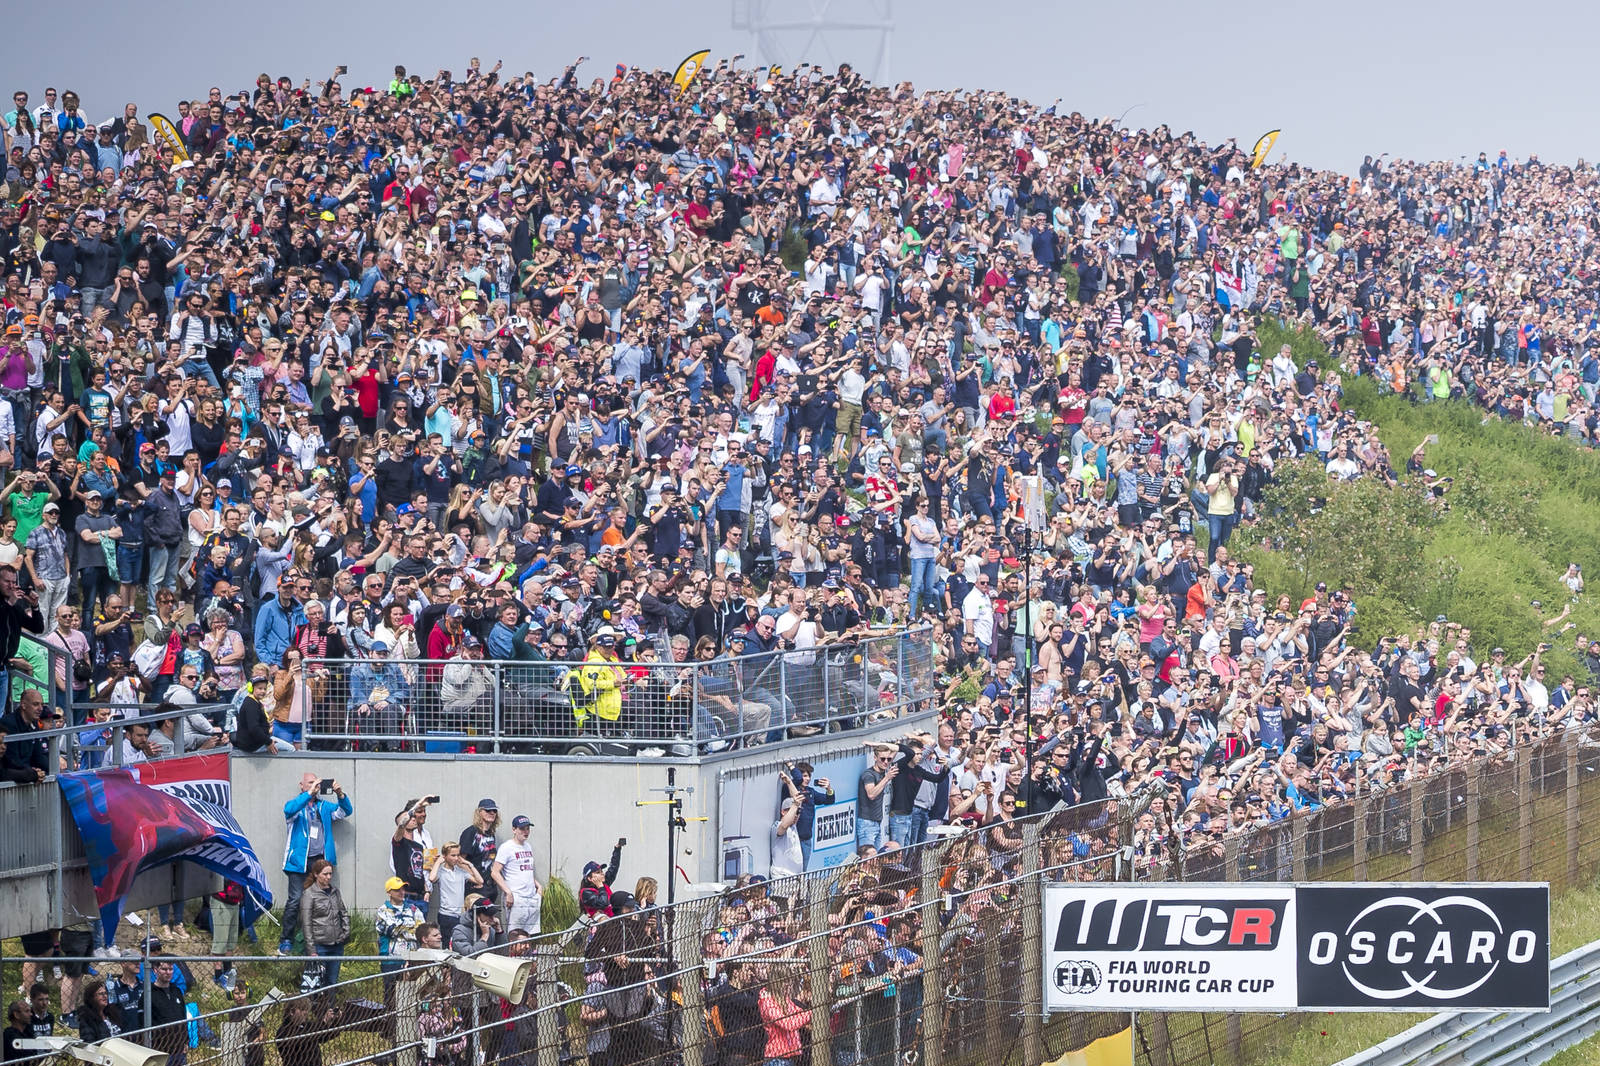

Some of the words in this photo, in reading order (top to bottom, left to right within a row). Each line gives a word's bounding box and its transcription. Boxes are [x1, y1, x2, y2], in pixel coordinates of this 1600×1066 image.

[816, 805, 855, 842] BERNIE'S
[1054, 899, 1278, 951] WTCR
[1308, 930, 1537, 965] OSCARO
[1108, 961, 1138, 974] FIA
[1143, 961, 1211, 974] WORLD
[1107, 979, 1191, 993] TOURING
[1195, 980, 1232, 993] CAR
[1238, 980, 1275, 993] CUP
